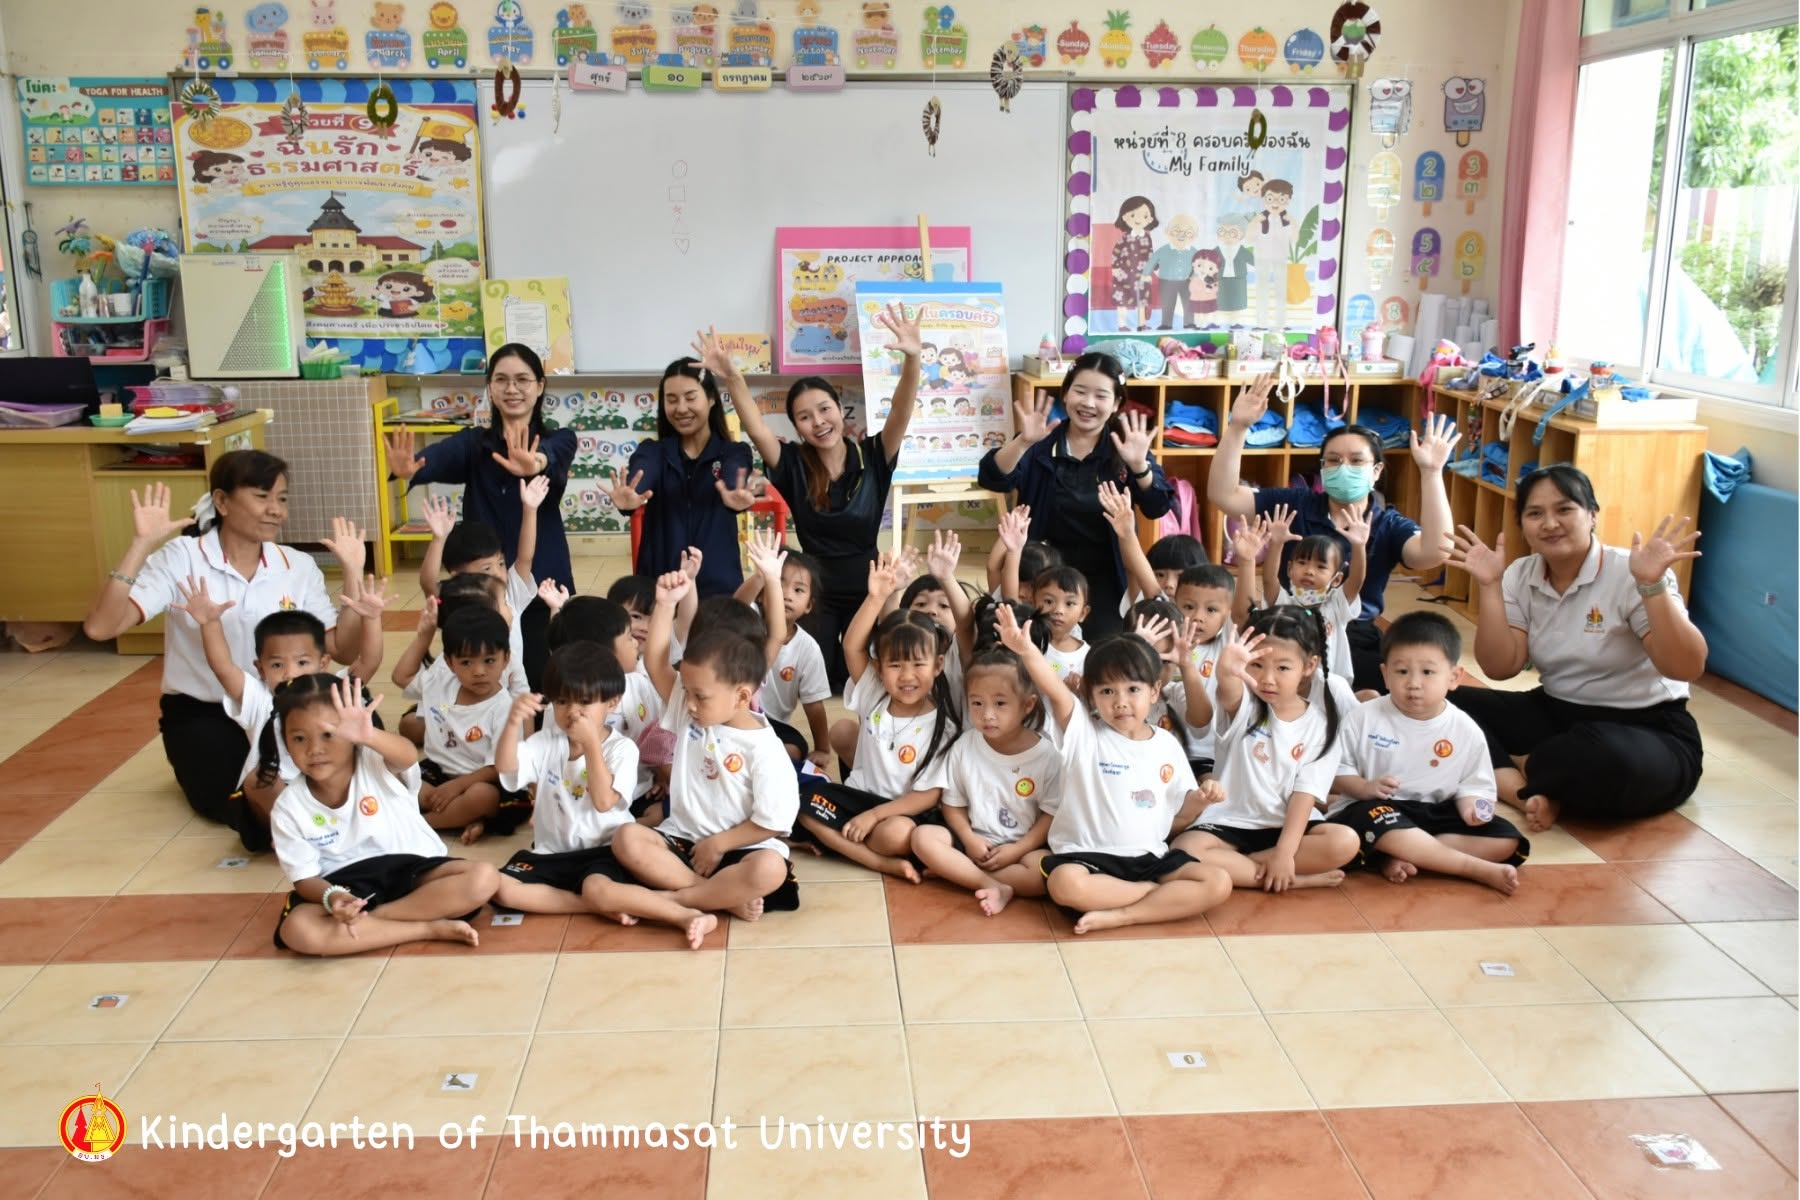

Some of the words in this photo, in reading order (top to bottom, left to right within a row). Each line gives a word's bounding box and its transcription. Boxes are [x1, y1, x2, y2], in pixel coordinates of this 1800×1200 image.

[501, 46, 521, 54] May
[1060, 39, 1089, 49] Sunday
[1146, 42, 1177, 51] Tuesday
[376, 49, 406, 58] March
[437, 47, 460, 57] April
[1291, 48, 1317, 58] Friday
[590, 72, 611, 85] ศุกร์
[722, 73, 767, 85] กรกฎาคม
[85, 87, 105, 96] YOGA
[111, 88, 127, 96] FOR
[131, 87, 163, 96] HEALTH
[1113, 126, 1169, 150] หน่วยที่
[1176, 131, 1186, 150] 8
[247, 159, 423, 177] ธรรมศาสตร์
[1168, 155, 1193, 177] My
[1199, 154, 1251, 176] Family
[1423, 158, 1436, 177] 2
[1467, 157, 1480, 176] 3
[1420, 233, 1432, 252] 5
[1464, 237, 1476, 253] 6
[827, 254, 873, 264] PROJECT
[877, 254, 932, 263] APPROAC
[1389, 303, 1399, 320] 8
[811, 793, 837, 812] KTU
[1368, 805, 1394, 818] KTU
